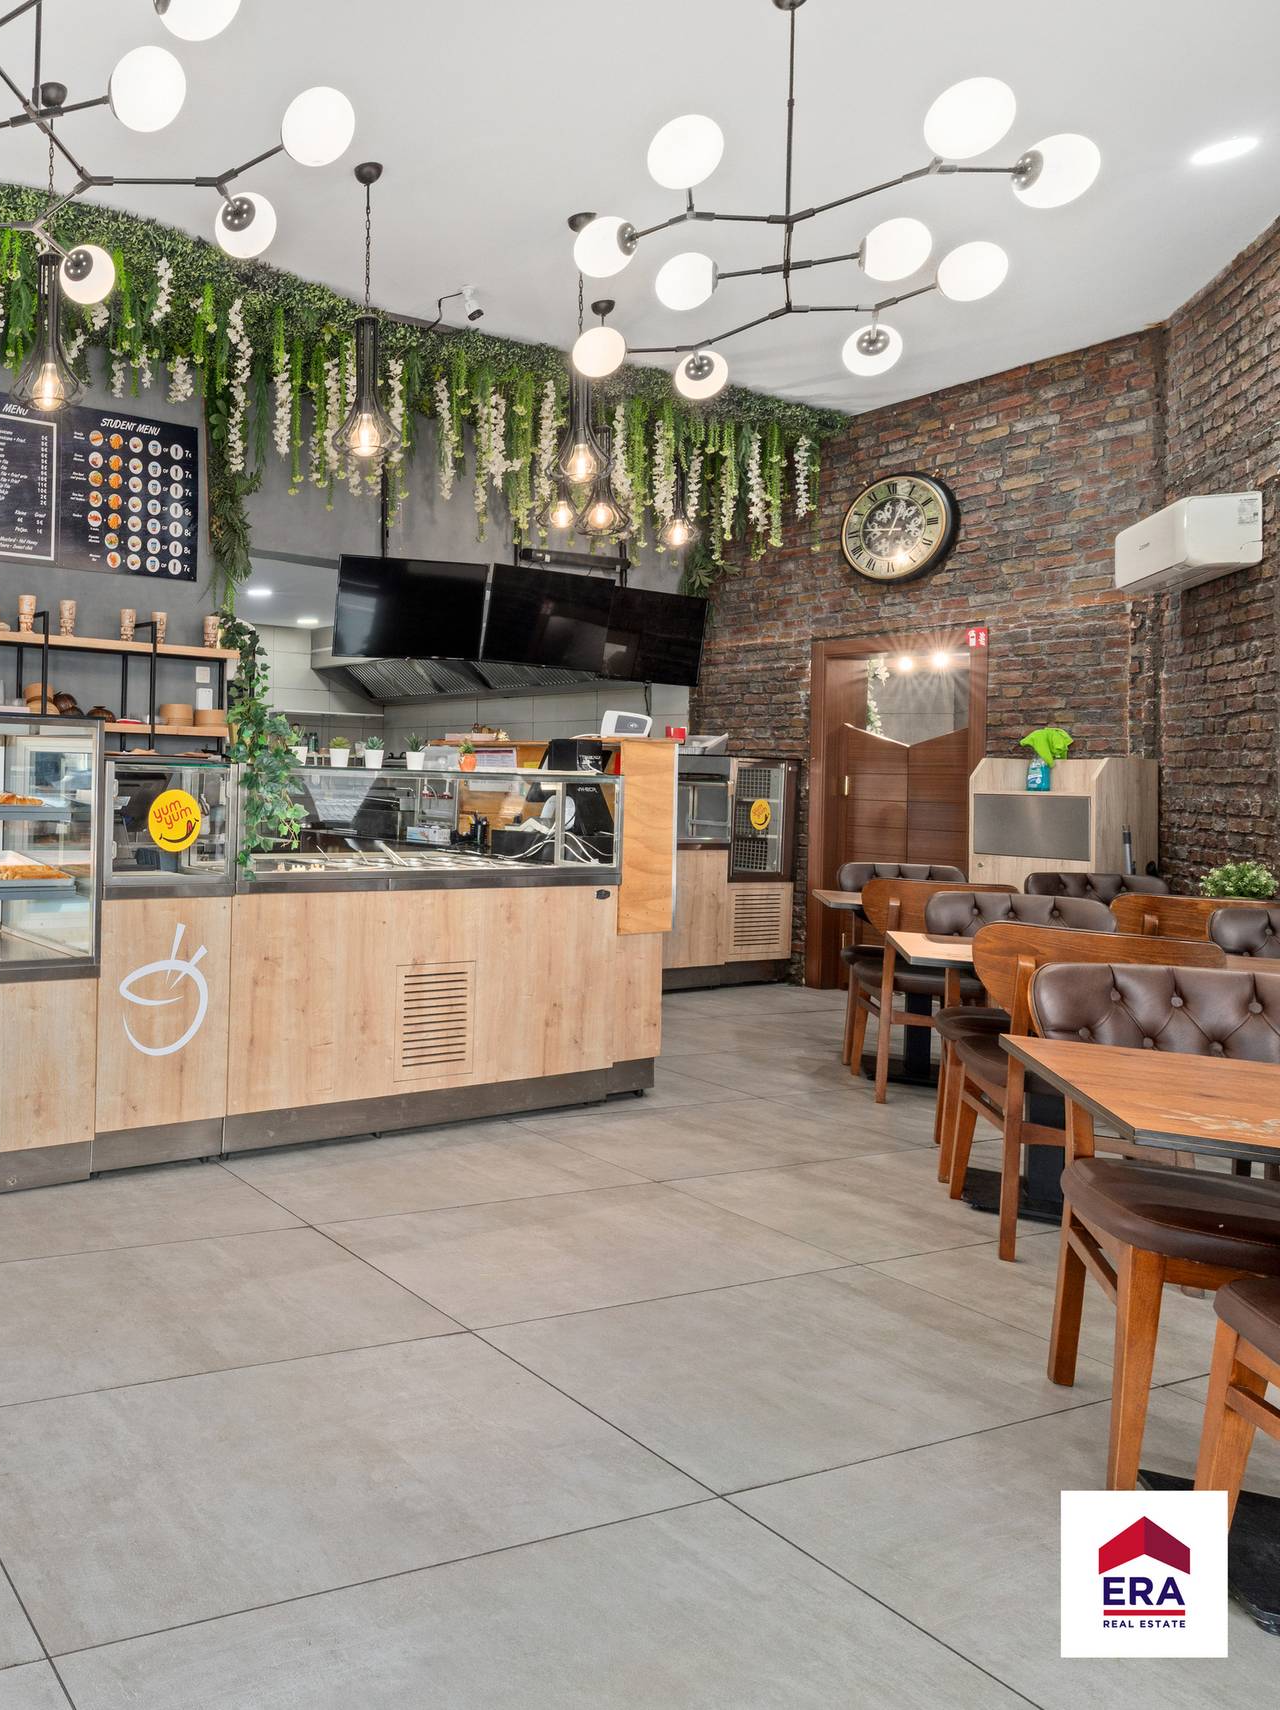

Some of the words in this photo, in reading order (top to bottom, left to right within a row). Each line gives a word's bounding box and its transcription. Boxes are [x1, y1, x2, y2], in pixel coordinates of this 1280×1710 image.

[2, 403, 28, 416] MENU
[100, 418, 136, 431] STUDENT
[136, 424, 160, 436] MENU
[153, 800, 181, 823] yum
[164, 806, 192, 829] yum
